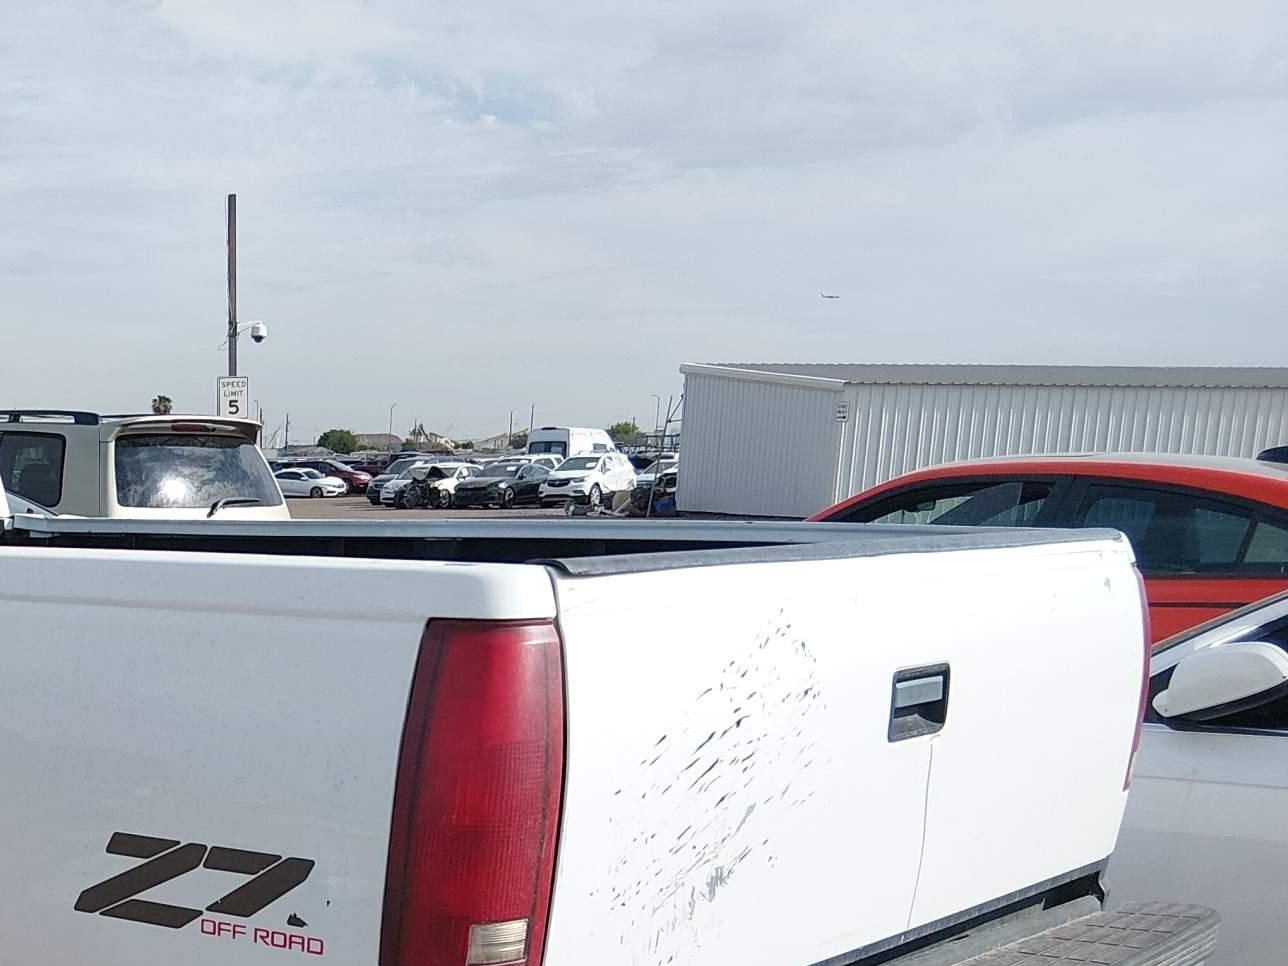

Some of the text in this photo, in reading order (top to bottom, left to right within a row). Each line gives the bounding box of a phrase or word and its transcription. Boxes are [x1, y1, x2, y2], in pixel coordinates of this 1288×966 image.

[221, 380, 247, 388] SPEED
[228, 399, 240, 415] 5
[200, 918, 325, 956] OFF ROAD
